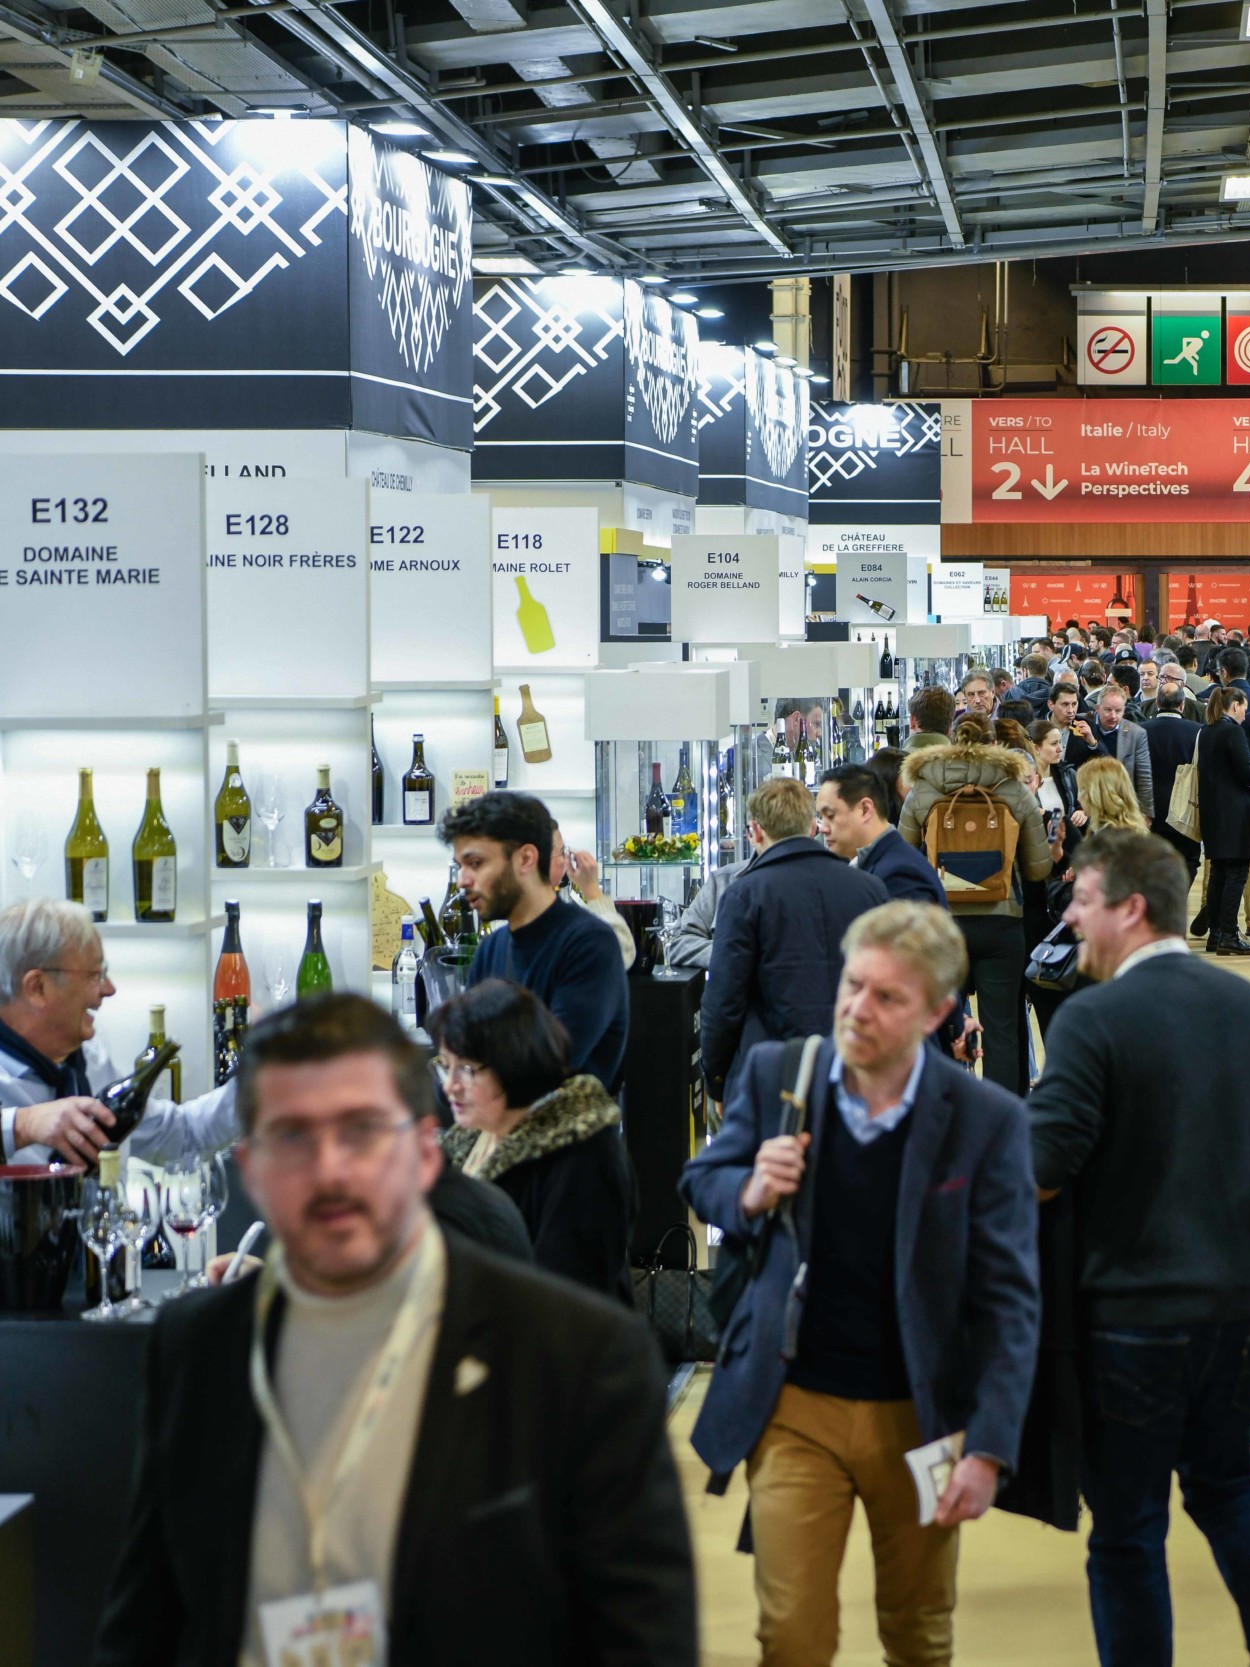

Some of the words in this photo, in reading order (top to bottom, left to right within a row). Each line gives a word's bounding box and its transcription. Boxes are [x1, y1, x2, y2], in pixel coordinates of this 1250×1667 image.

[941, 415, 962, 426] RE
[989, 417, 1024, 427] VERS
[1034, 417, 1052, 427] TO
[1081, 423, 1123, 437] Italie
[1137, 423, 1171, 440] Italy
[990, 437, 1054, 454] HALL
[1081, 463, 1100, 476] La
[1105, 462, 1188, 476] WineTech
[990, 461, 1023, 500] 2
[1081, 481, 1190, 497] Perspectives
[32, 497, 109, 523] E132
[225, 514, 290, 536] E128
[370, 525, 425, 544] E122
[497, 534, 543, 549] E118
[840, 532, 886, 542] CHÂTEAU
[23, 546, 118, 562] DOMAINE
[822, 544, 835, 552] DE
[837, 544, 850, 552] LA
[852, 543, 904, 552] GREFFIERE
[206, 554, 236, 568] INE
[242, 554, 283, 568] NOIR
[289, 551, 357, 568] FRÈRES
[707, 552, 740, 564] E104
[370, 560, 394, 571] ME
[398, 560, 460, 571] ARNOUX
[530, 563, 571, 573] ROLET
[861, 564, 883, 572] E084
[16, 569, 89, 585] SAINTE
[96, 568, 160, 584] MARIE
[704, 572, 744, 580] DOMAINE
[687, 581, 718, 589] ROGER
[720, 581, 760, 589] BELLAND
